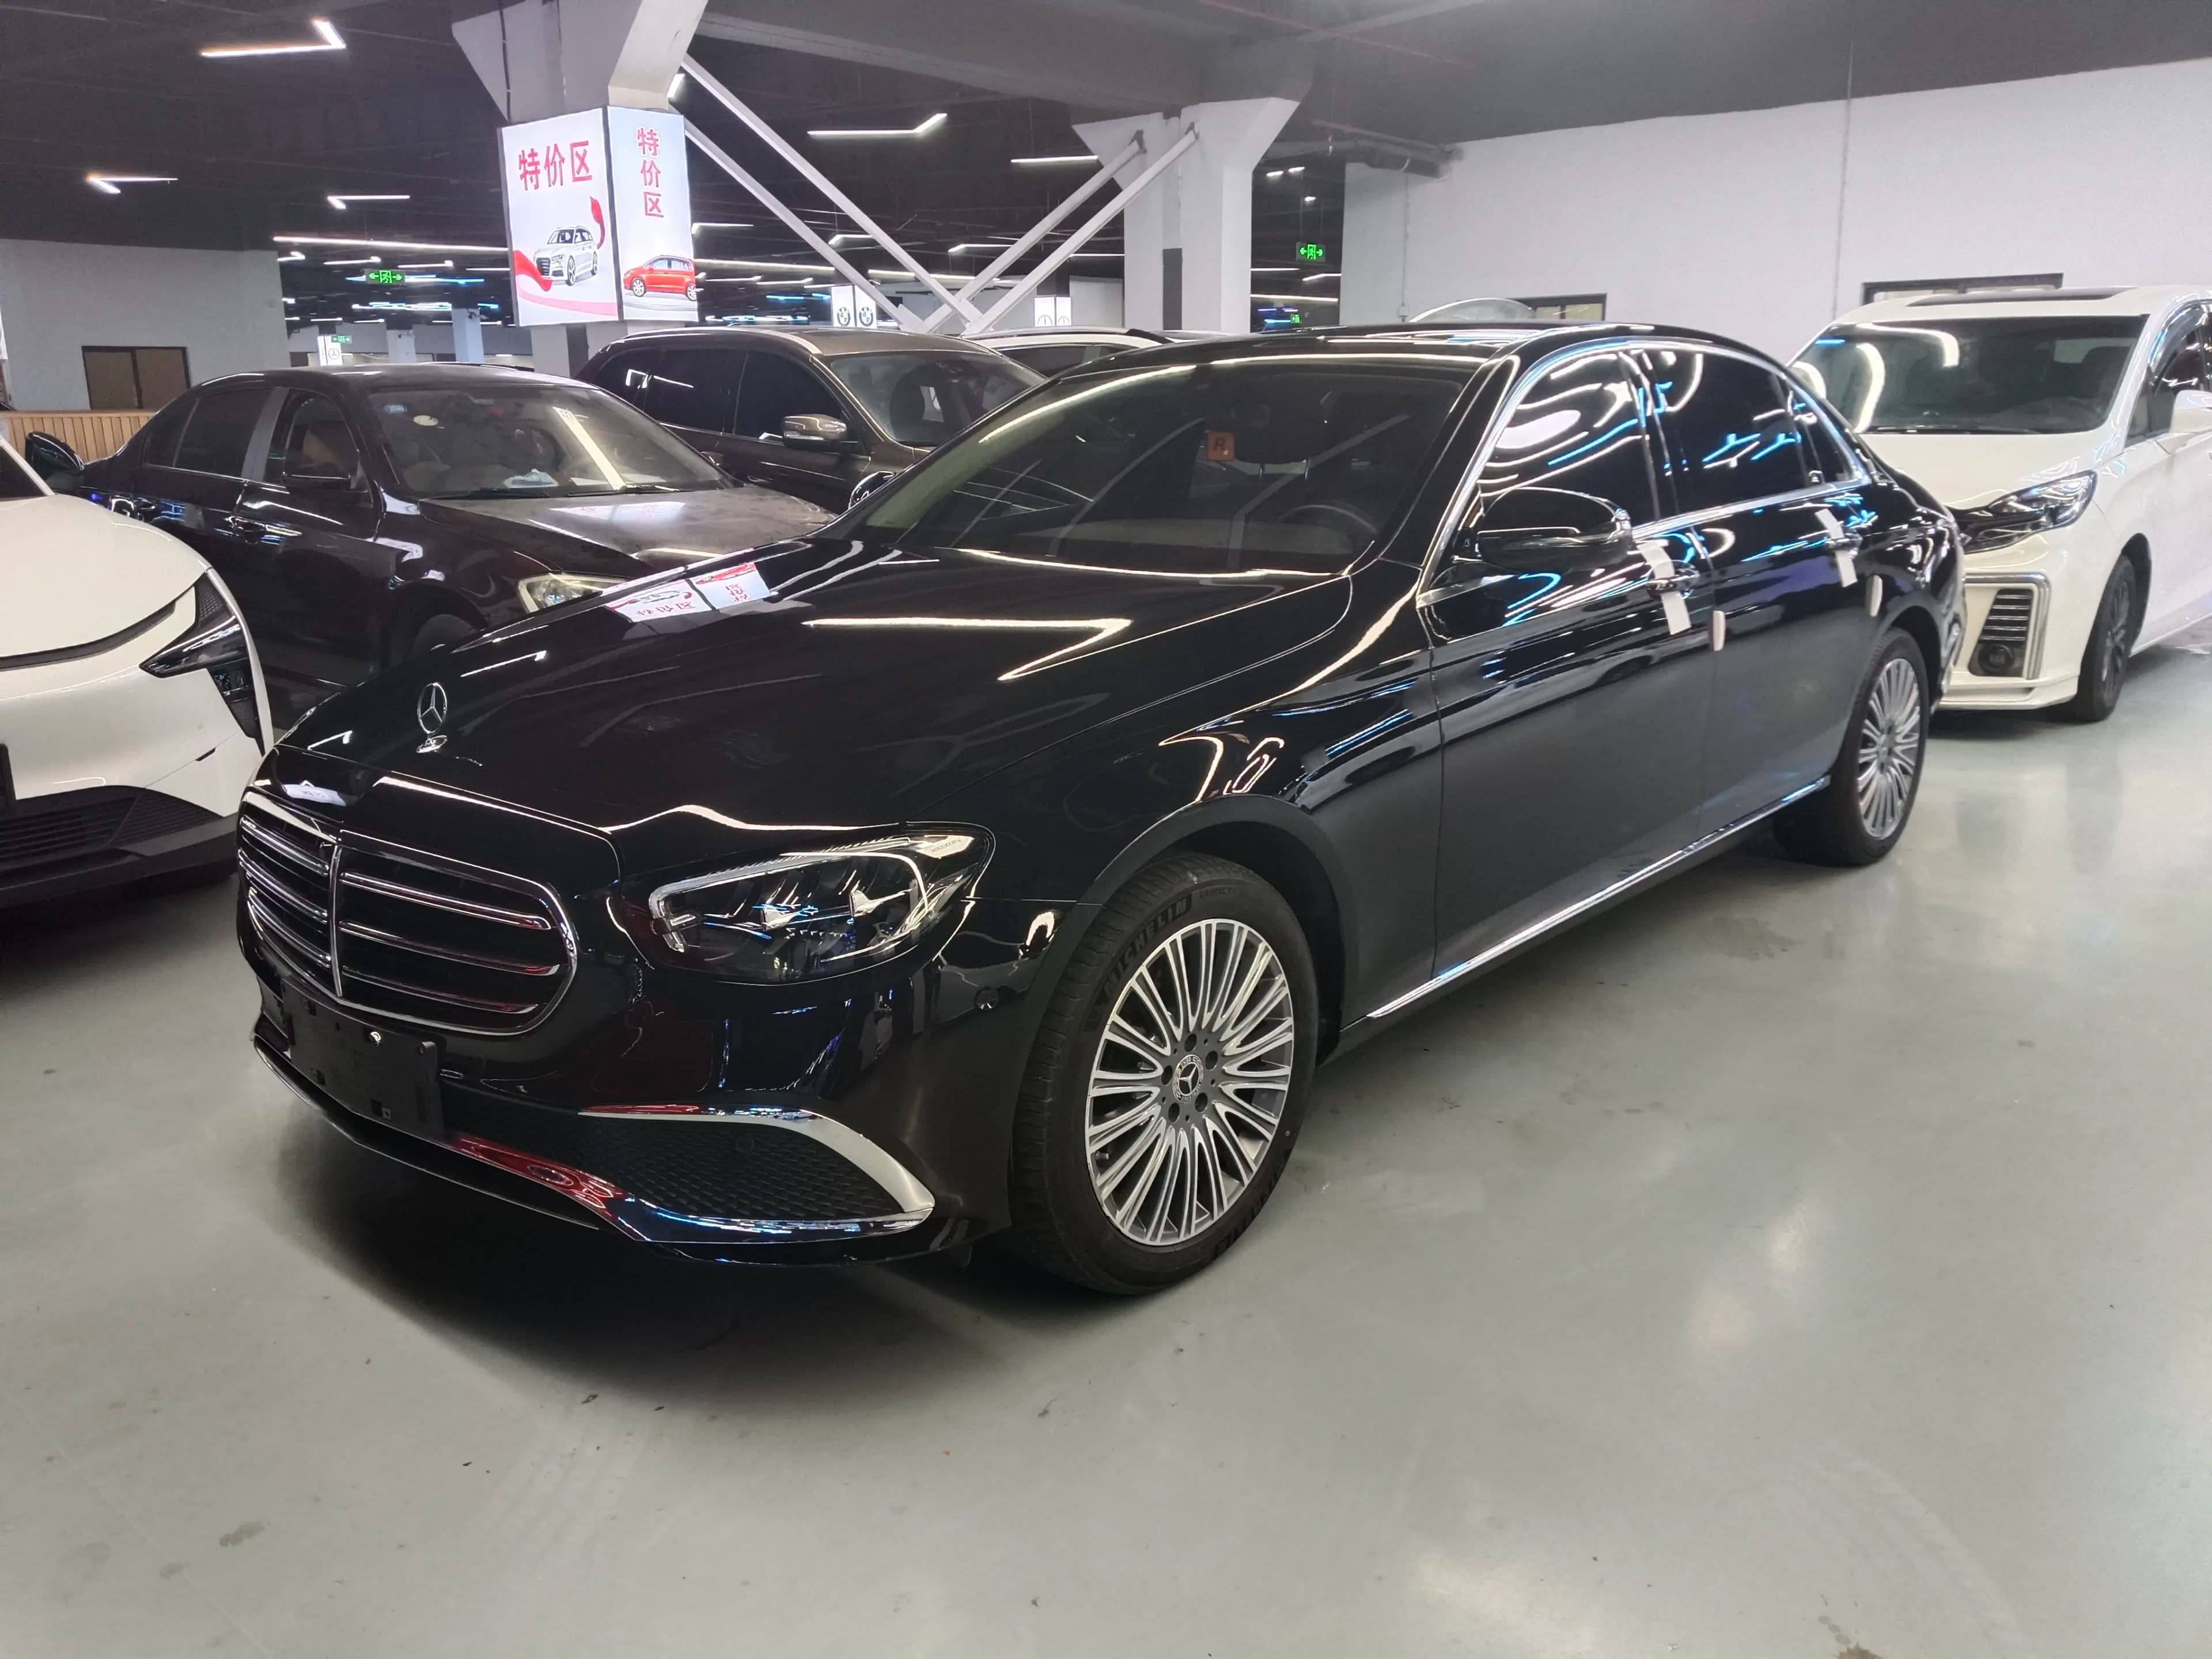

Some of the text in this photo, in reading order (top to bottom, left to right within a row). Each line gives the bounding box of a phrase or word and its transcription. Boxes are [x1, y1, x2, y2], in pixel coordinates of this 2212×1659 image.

[519, 141, 592, 191] 特价区
[637, 127, 664, 218] 特价区
[1103, 897, 1188, 994] MICHELIN
